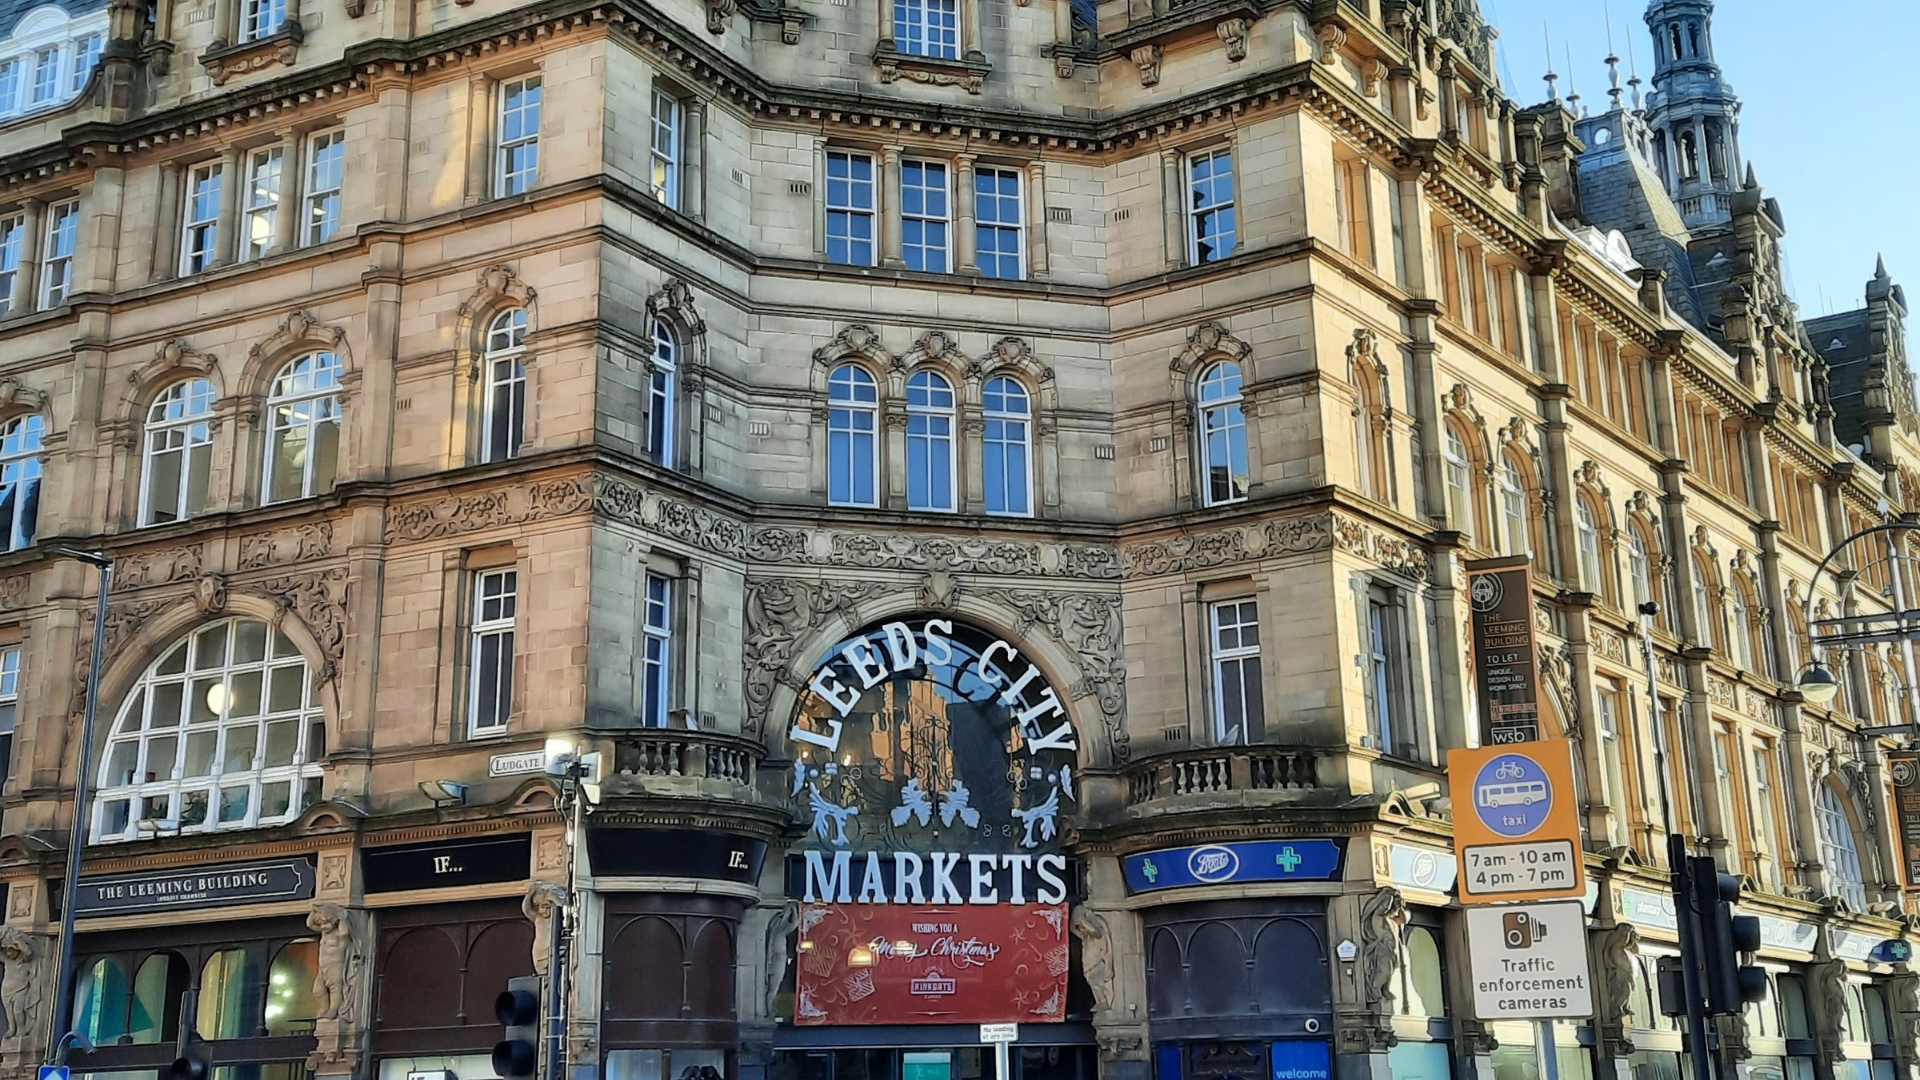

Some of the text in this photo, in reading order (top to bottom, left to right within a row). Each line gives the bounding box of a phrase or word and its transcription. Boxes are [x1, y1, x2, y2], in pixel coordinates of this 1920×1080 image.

[1488, 653, 1519, 664] TO LET
[790, 619, 1076, 754] LEEDS CITY
[495, 757, 540, 772] LUDGATE
[1503, 815, 1527, 827] taxi
[1471, 854, 1480, 868] 7
[1483, 855, 1507, 867] am
[1519, 849, 1538, 865] 10
[1542, 850, 1566, 863] am
[803, 850, 1068, 905] MARKETS
[1476, 870, 1487, 885] 4
[1490, 872, 1515, 887] pm
[1527, 868, 1537, 882] 7
[1540, 869, 1565, 884] pm
[98, 873, 268, 900] THE LEEMING BUILDING
[953, 922, 959, 933] A
[930, 935, 1000, 969] Christmas
[1501, 957, 1556, 973] Traffic
[1479, 974, 1585, 993] enforcement
[1498, 997, 1568, 1010] cameras
[1276, 1068, 1328, 1080] welcome
